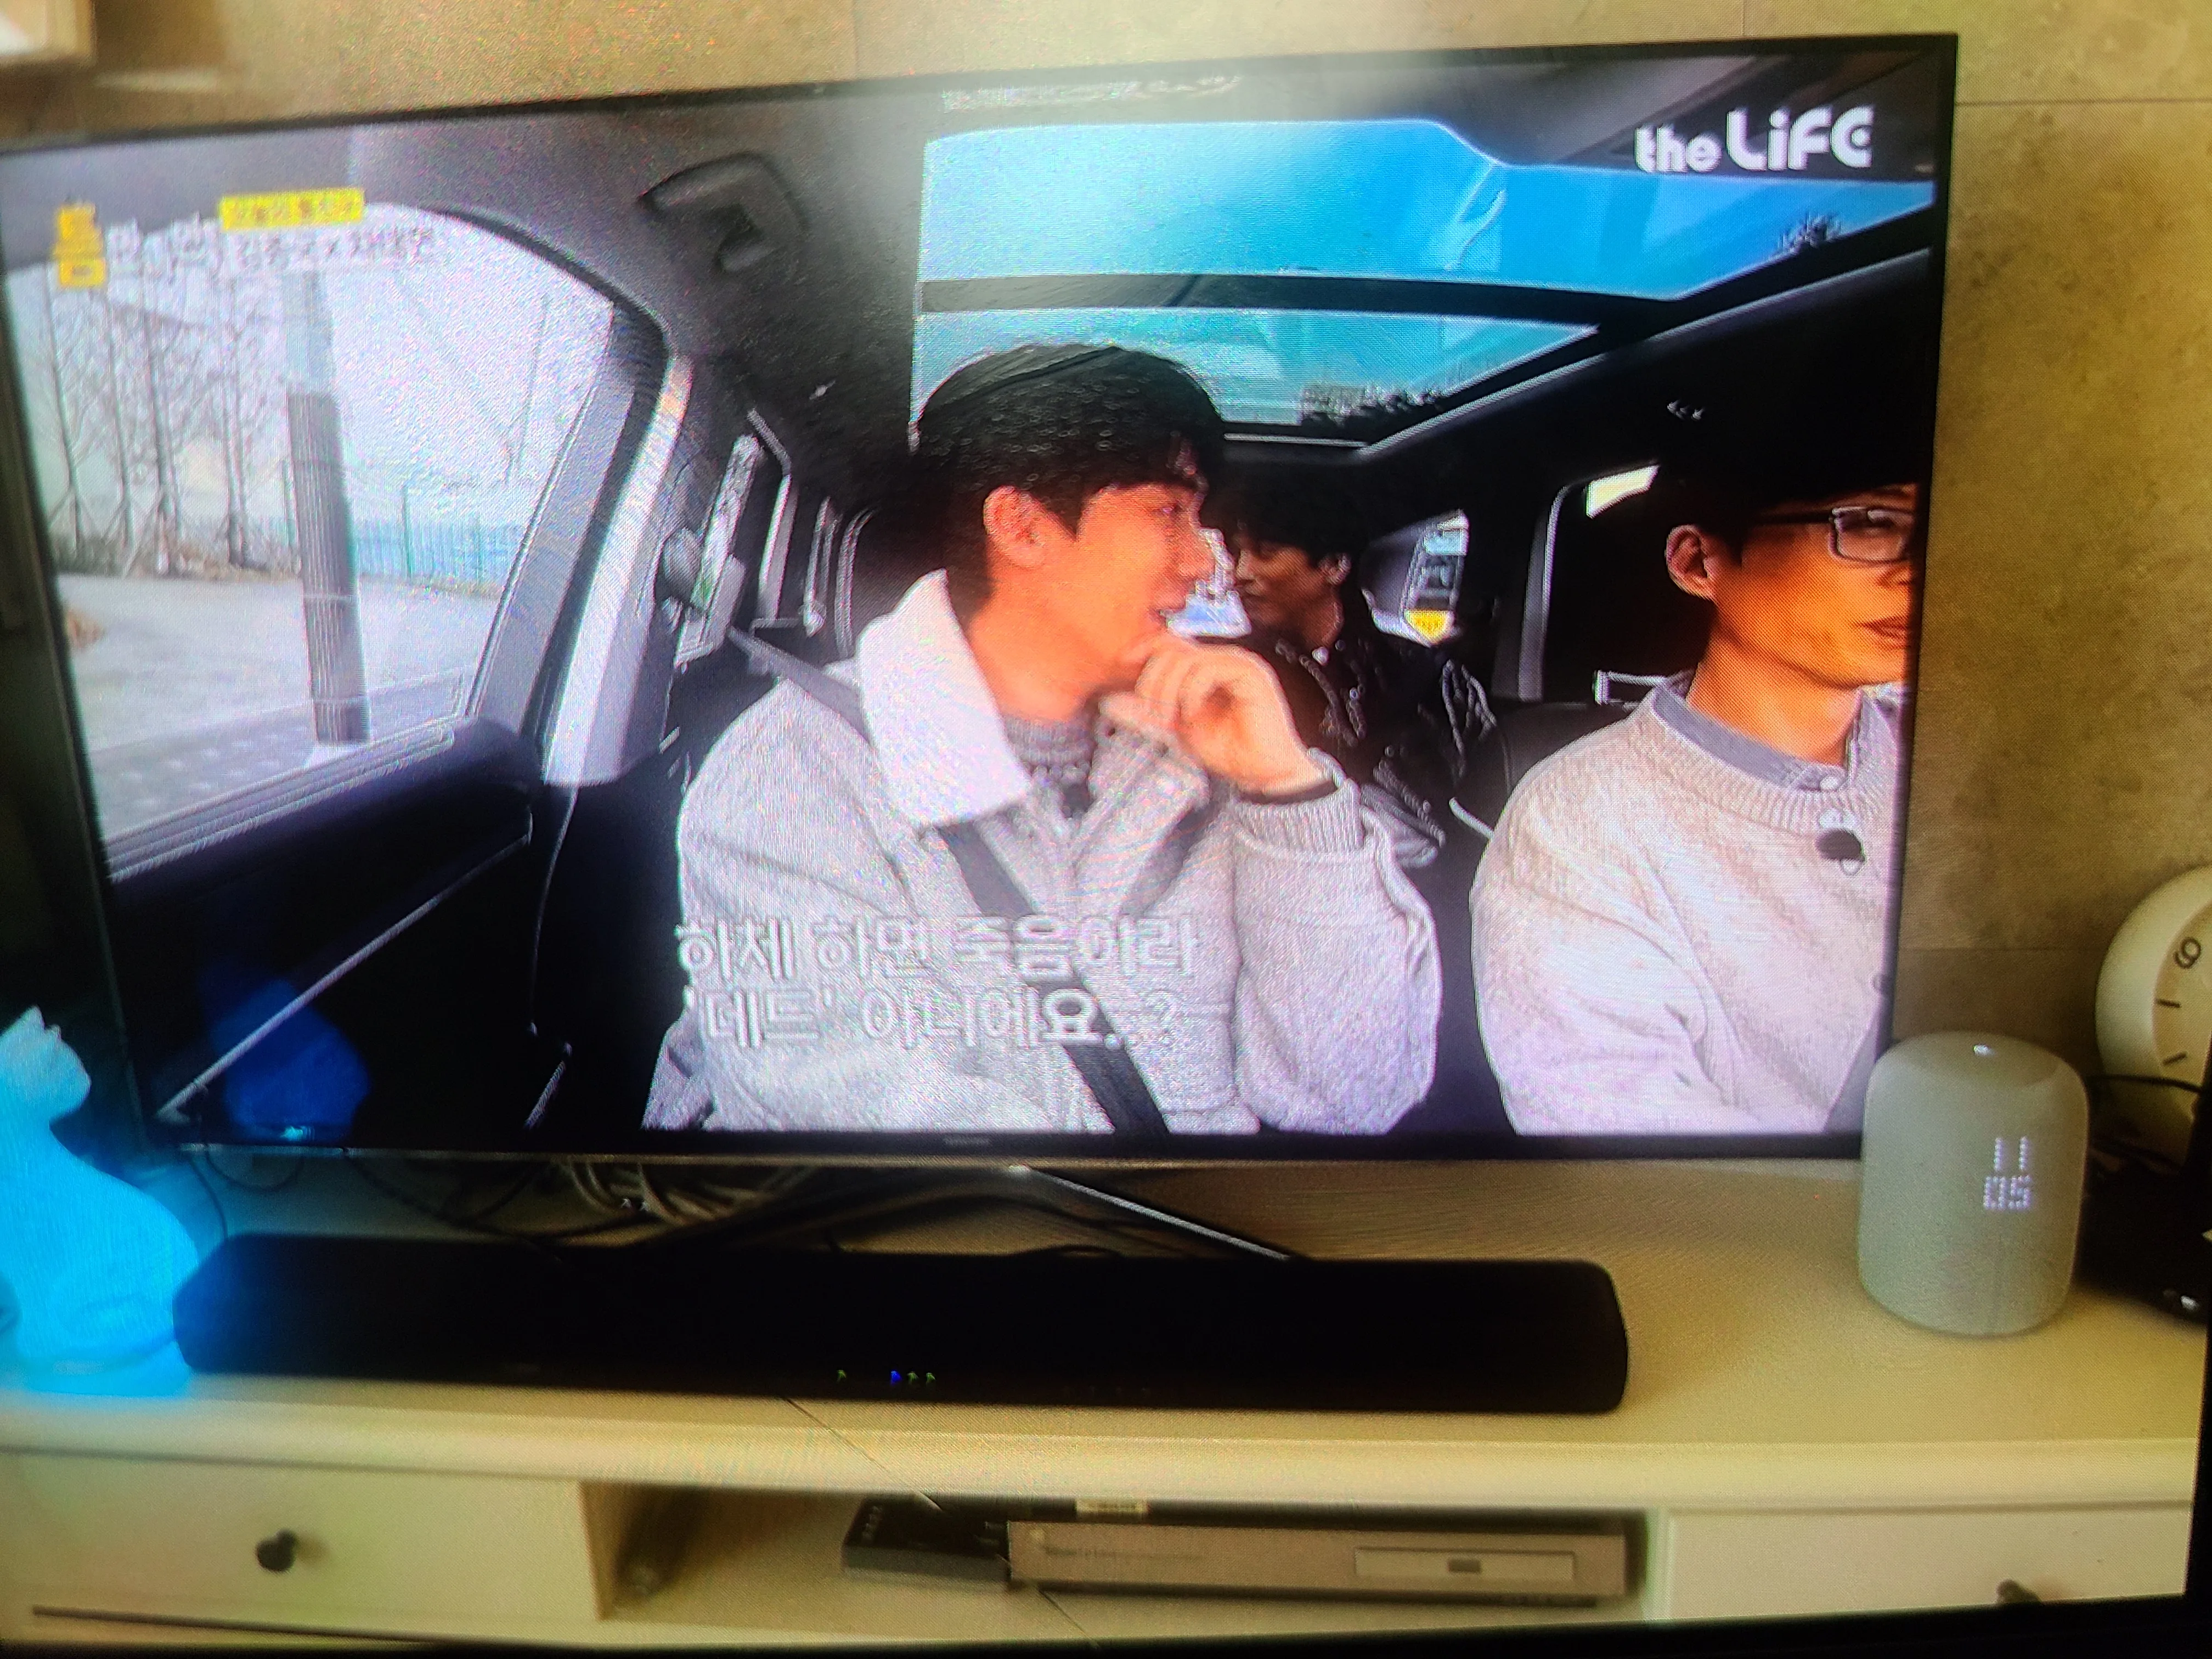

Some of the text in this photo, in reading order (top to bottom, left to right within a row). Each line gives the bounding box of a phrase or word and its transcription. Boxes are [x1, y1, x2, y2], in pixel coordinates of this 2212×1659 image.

[1634, 123, 1722, 173] the
[678, 915, 1199, 982] 하체 하면 죽음이라
[1993, 1136, 2030, 1171] 11
[1983, 1175, 2032, 1210] 05
